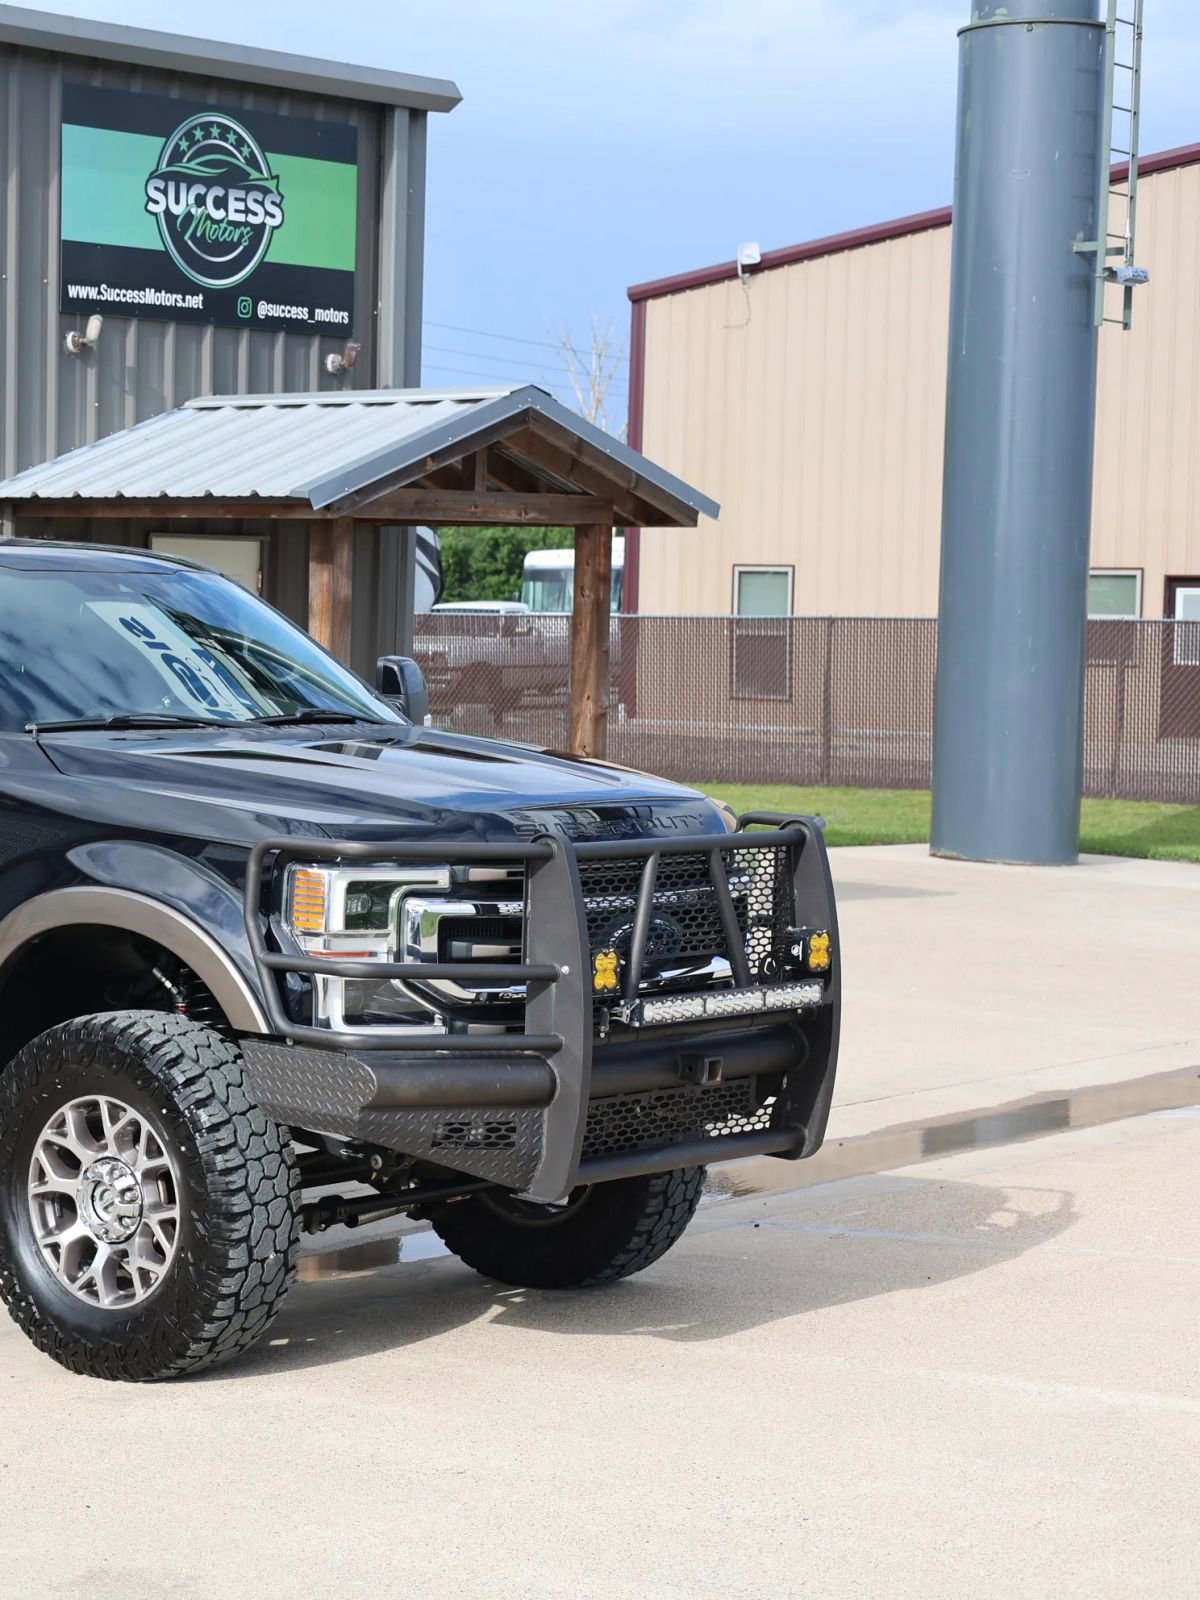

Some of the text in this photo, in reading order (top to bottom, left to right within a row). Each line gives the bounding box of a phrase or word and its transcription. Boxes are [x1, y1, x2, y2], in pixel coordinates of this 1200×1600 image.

[147, 178, 283, 227] SUCCESS
[176, 202, 255, 246] Motors
[67, 283, 204, 309] www.SuccessMotors.net
[257, 300, 349, 324] @success_motors
